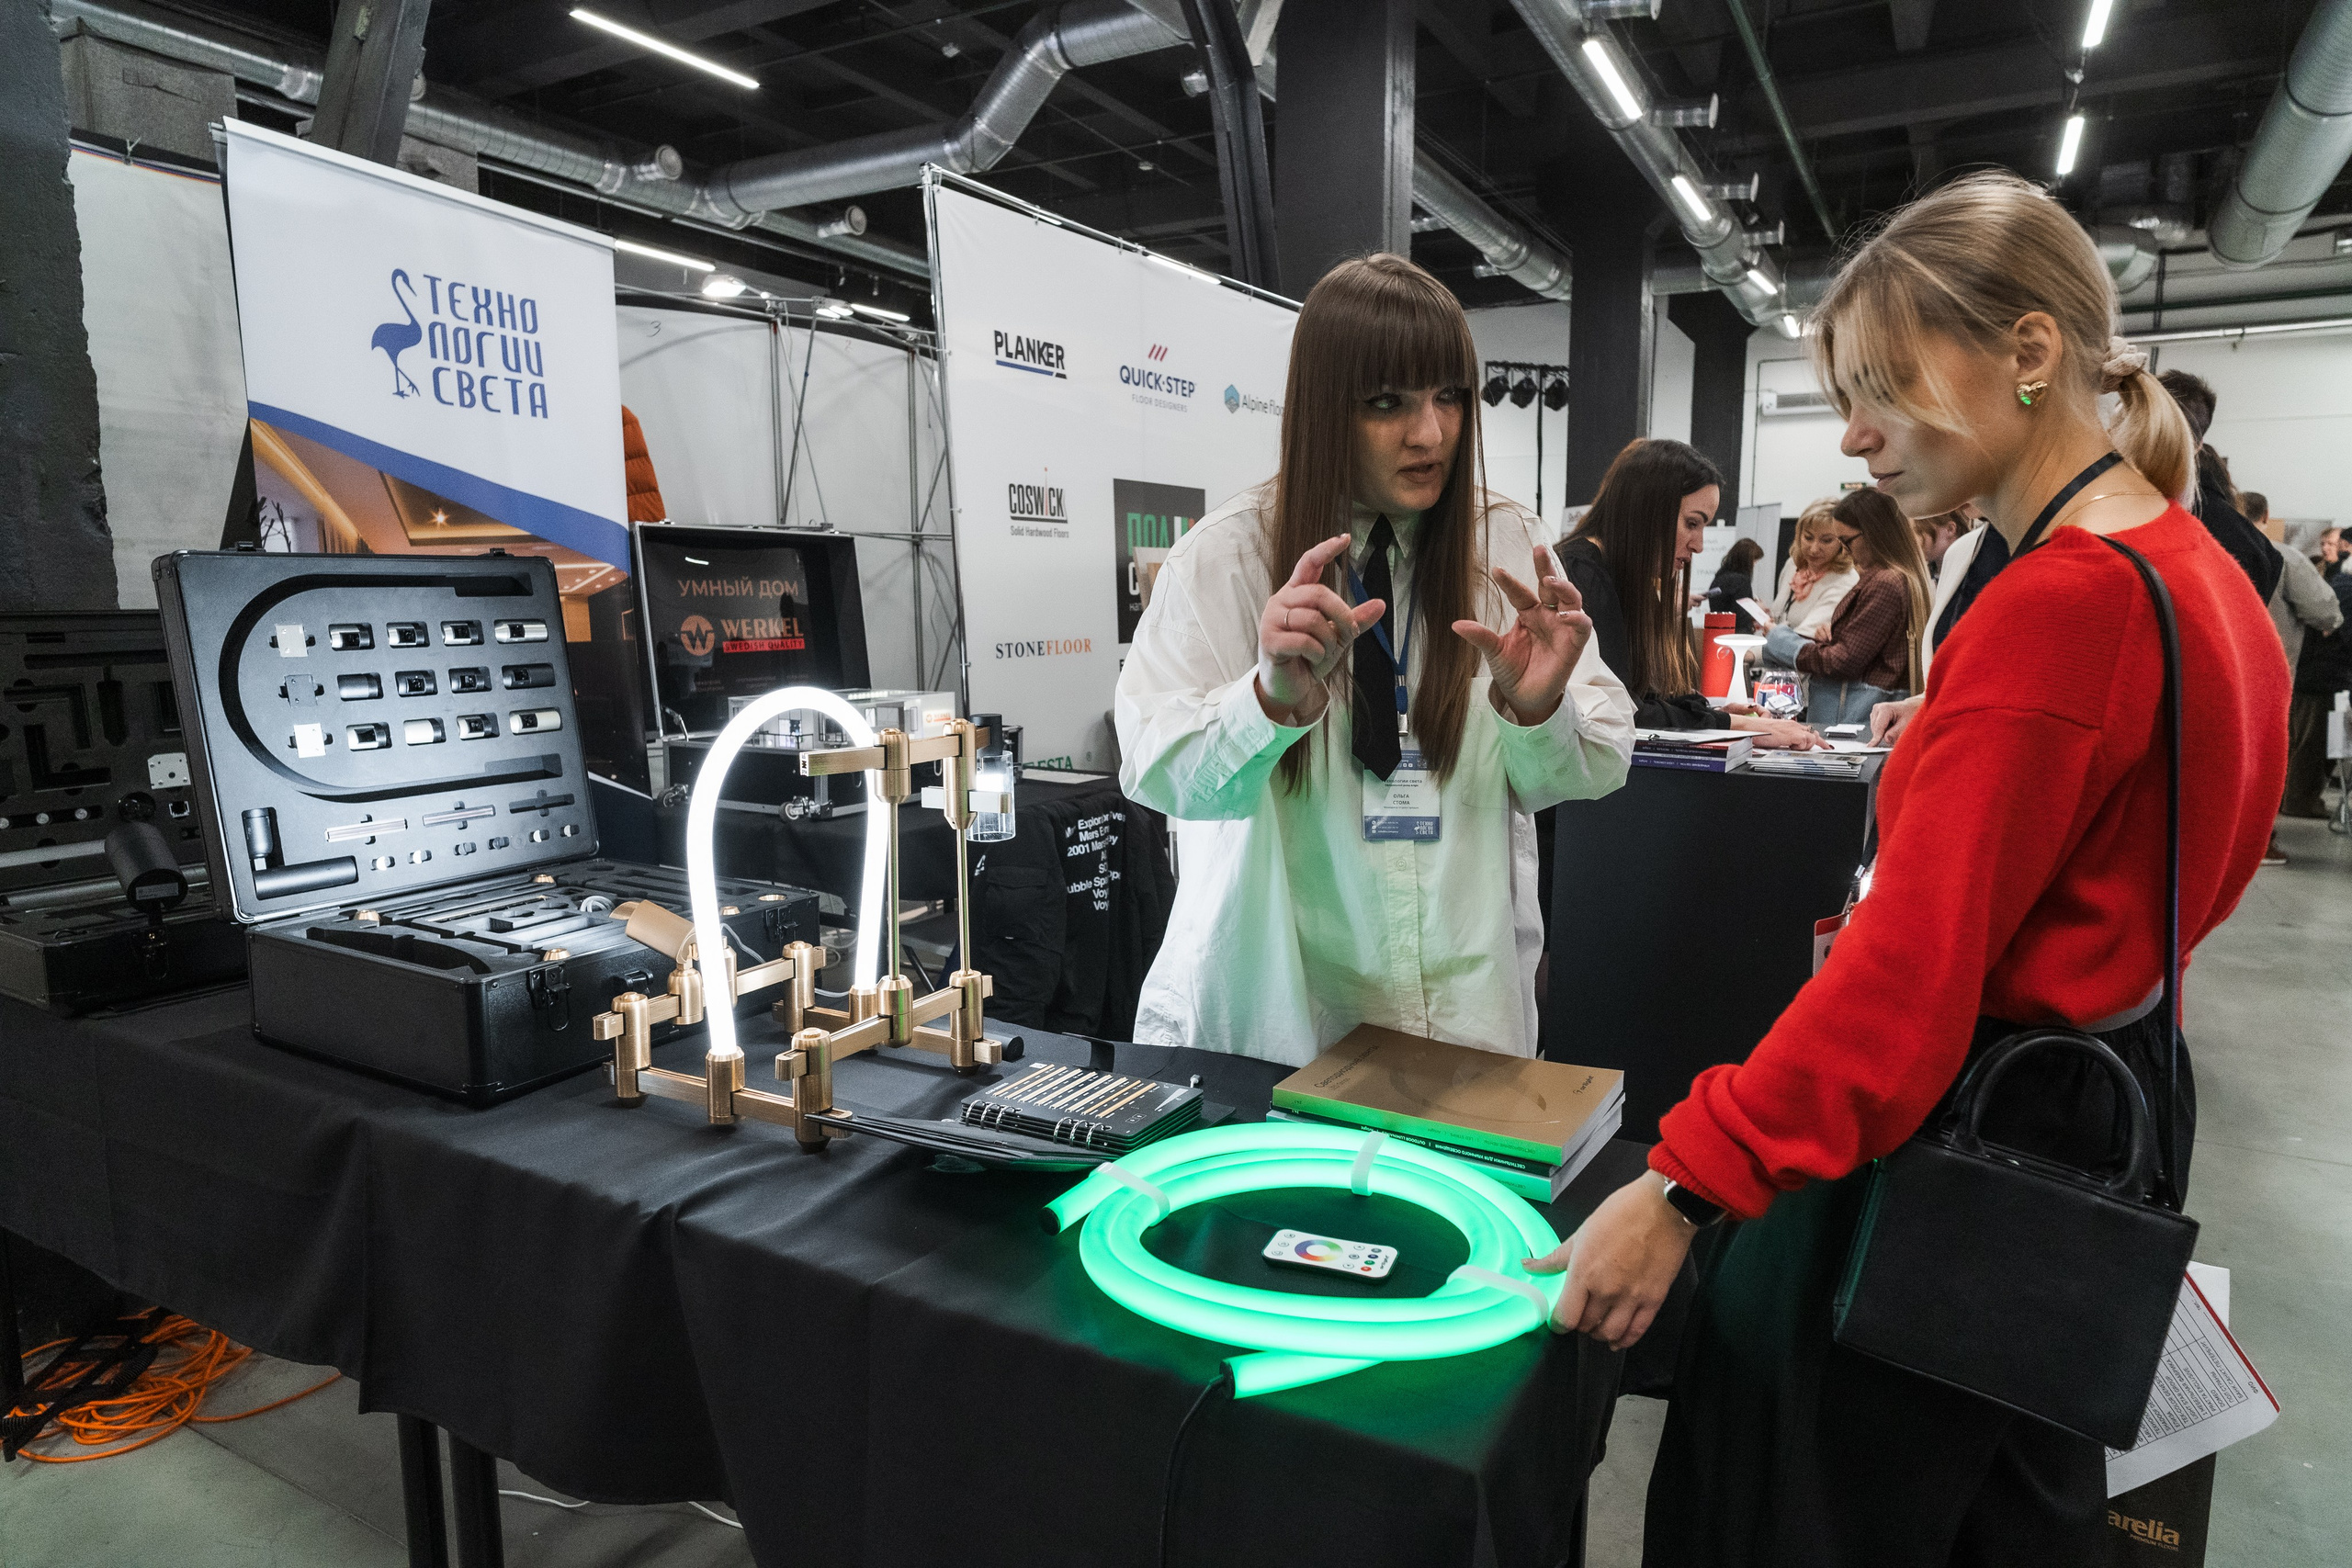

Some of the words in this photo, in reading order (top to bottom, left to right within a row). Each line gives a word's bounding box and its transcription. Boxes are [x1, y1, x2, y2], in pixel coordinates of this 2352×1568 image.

[424, 274, 538, 334] ТЕХНО
[428, 321, 544, 378] ЛОГИИ
[994, 330, 1065, 370] PLANKER
[432, 367, 548, 419] СВЕТА
[1132, 393, 1153, 406] FLOOR
[1154, 399, 1188, 413] DESIGNERS
[1241, 393, 1269, 414] Alpine
[1009, 474, 1065, 517] COSWICK
[1010, 525, 1024, 536] Solid
[1025, 526, 1053, 538] Hardwood
[1054, 528, 1069, 538] Floors
[678, 575, 754, 598] УМНЫЙ
[759, 580, 799, 599] ДОМ
[720, 617, 805, 639] WERKEL
[725, 641, 765, 651] SWEDISH
[767, 639, 803, 649] QUALITY
[995, 637, 1092, 660] STONEFLOOR
[1079, 829, 1100, 842] Mars
[1067, 843, 1091, 857] 2001
[1405, 1135, 1426, 1145] OUTDOOR
[1434, 1142, 1462, 1154] ОСВЕЩЕНИЯ
[1460, 1149, 1484, 1159] УЛИЧНОГО
[1492, 1156, 1526, 1169] СВЕТИЛЬНИКИ
[2165, 1358, 2185, 1382] ФАБРИКА
[2199, 1339, 2233, 1384] САНКТ-ПЕТЕРБУРГ
[2165, 1374, 2180, 1393] GROUP
[2182, 1366, 2204, 1393] EXCLUSIVE
[2209, 1371, 2227, 1392] СТРАНЫ
[2246, 1380, 2259, 1393] ФИО
[2176, 1391, 2188, 1404] STAR
[2181, 1382, 2205, 1412] МЕБЕЛЬНАЯ
[2223, 1391, 2234, 1403] ПОЛ
[2231, 1384, 2244, 1398] БАНК
[2167, 1395, 2189, 1423] TEX-COLOR
[2185, 1404, 2199, 1420] LIGHT
[2200, 1392, 2217, 1412] PRATTA
[2107, 1509, 2181, 1547] arelia
